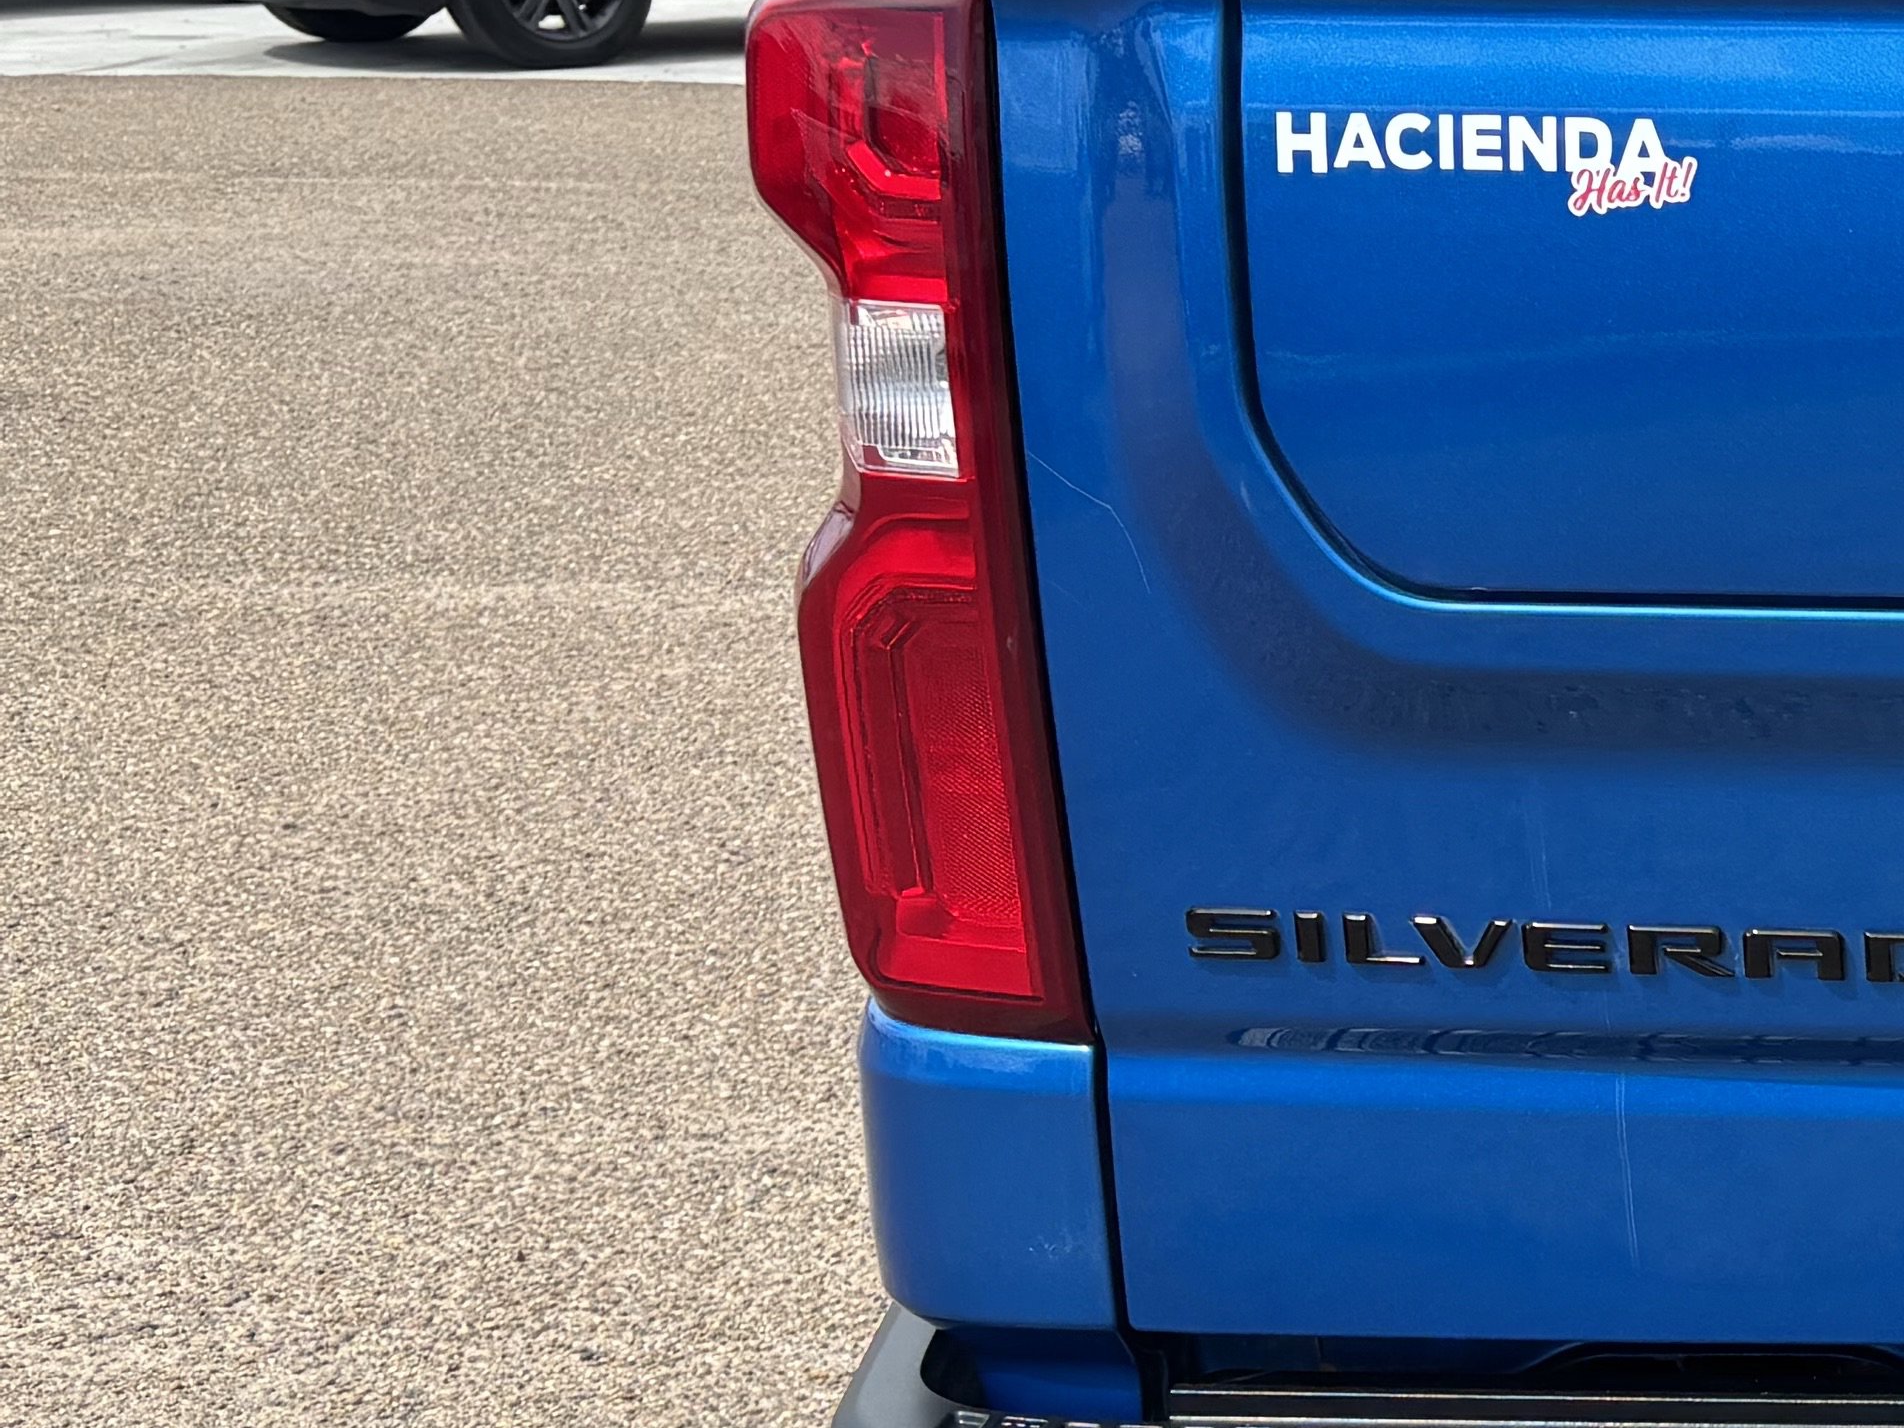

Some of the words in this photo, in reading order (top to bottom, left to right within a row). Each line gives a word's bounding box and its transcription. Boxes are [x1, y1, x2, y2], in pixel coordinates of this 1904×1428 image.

[1275, 110, 1667, 176] HACIENDA
[1571, 165, 1644, 214] Has
[1649, 159, 1695, 205] It!
